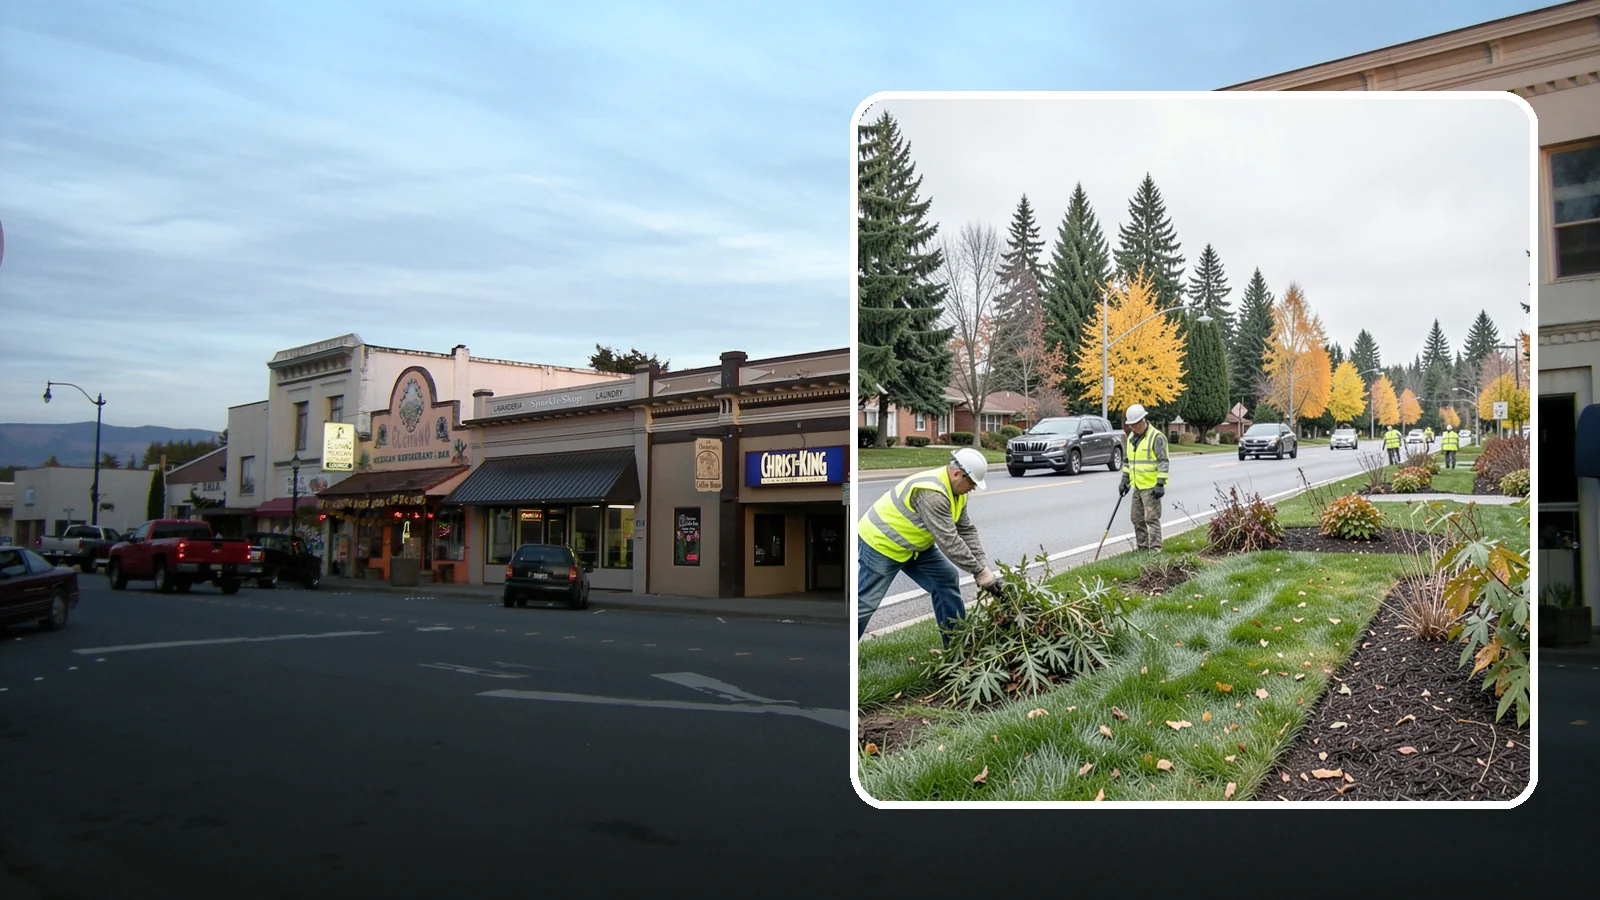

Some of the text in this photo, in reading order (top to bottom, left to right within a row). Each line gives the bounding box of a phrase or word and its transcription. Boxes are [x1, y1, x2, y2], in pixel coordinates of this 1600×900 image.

[561, 394, 583, 405] Shop
[595, 388, 624, 400] LAUNDRY
[493, 401, 523, 413] LAVANDERIA
[373, 454, 397, 464] MEXICAN
[397, 451, 434, 463] RESTAURANT
[438, 449, 450, 459] BAR
[799, 449, 828, 477] KING
